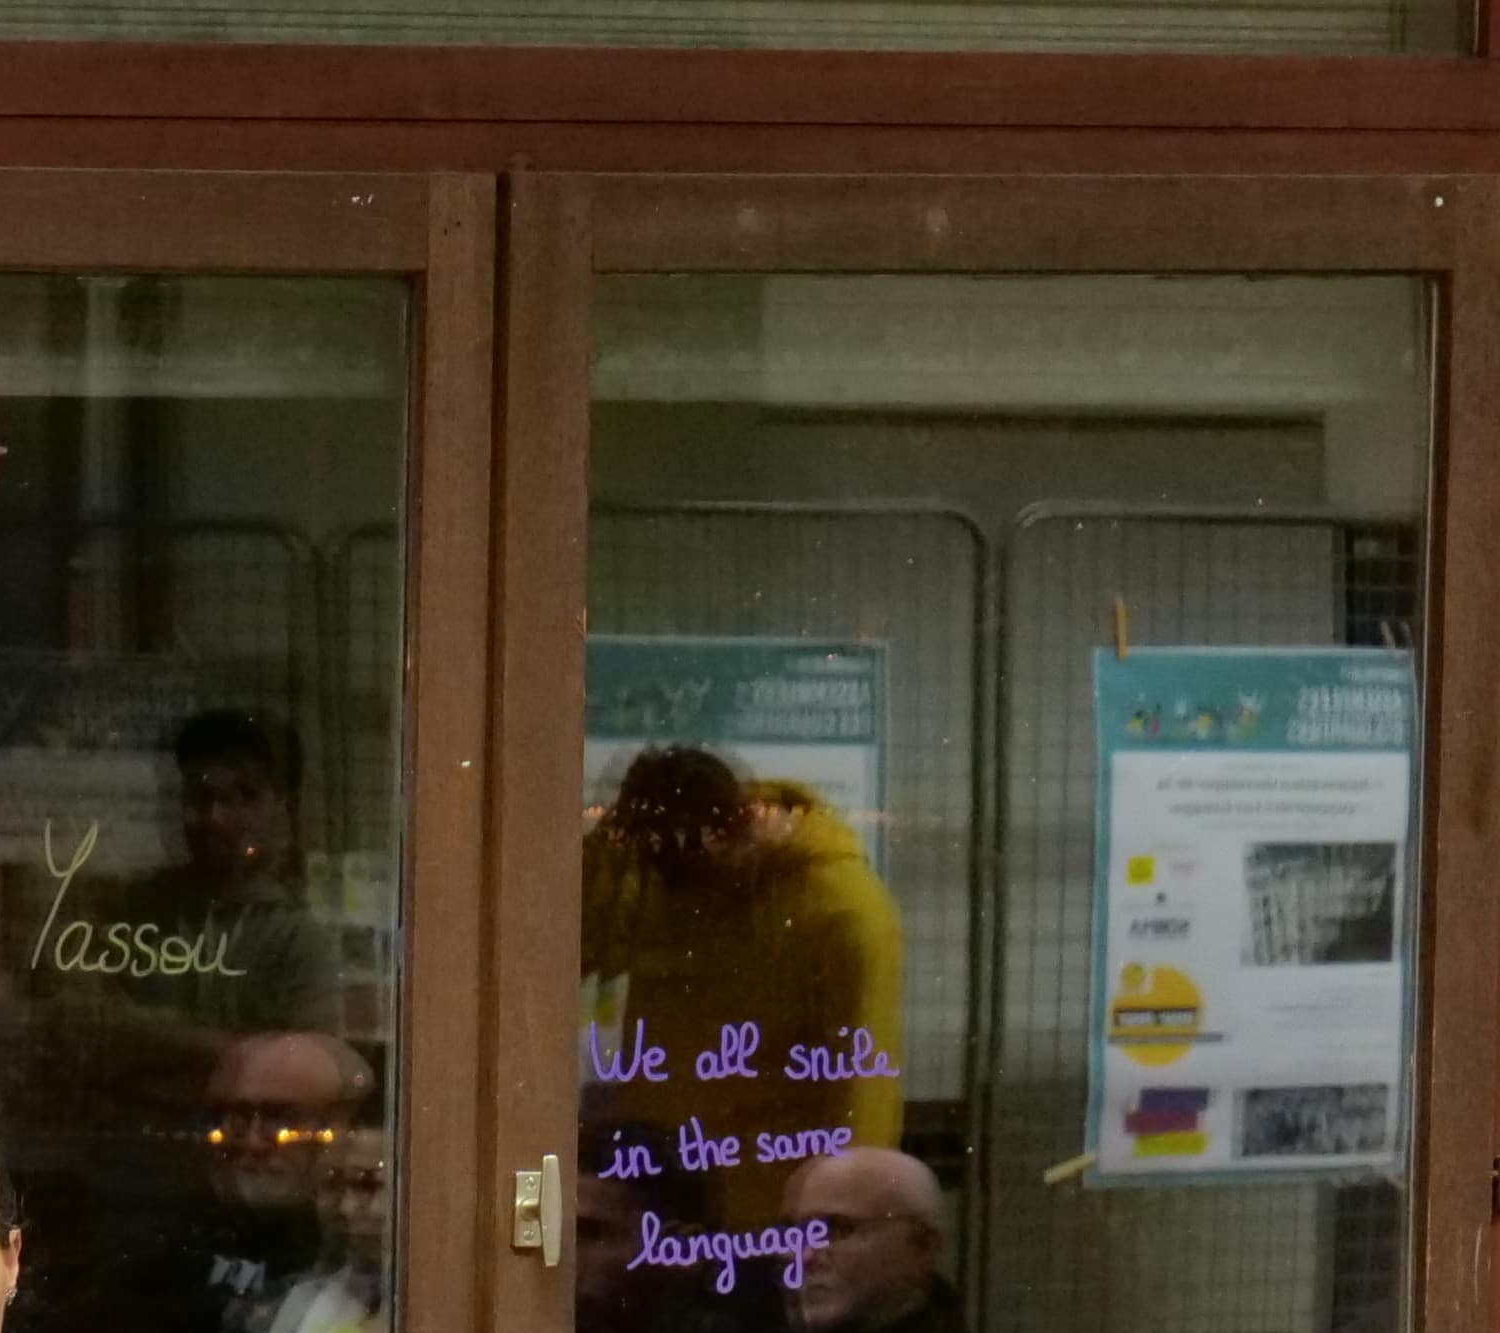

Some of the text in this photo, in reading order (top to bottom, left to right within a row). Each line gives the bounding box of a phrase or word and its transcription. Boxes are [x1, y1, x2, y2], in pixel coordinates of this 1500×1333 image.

[31, 818, 248, 977] Yassou
[588, 1018, 668, 1082] We
[695, 1021, 758, 1081] all
[598, 1115, 852, 1179] in the same
[627, 1210, 830, 1295] language
